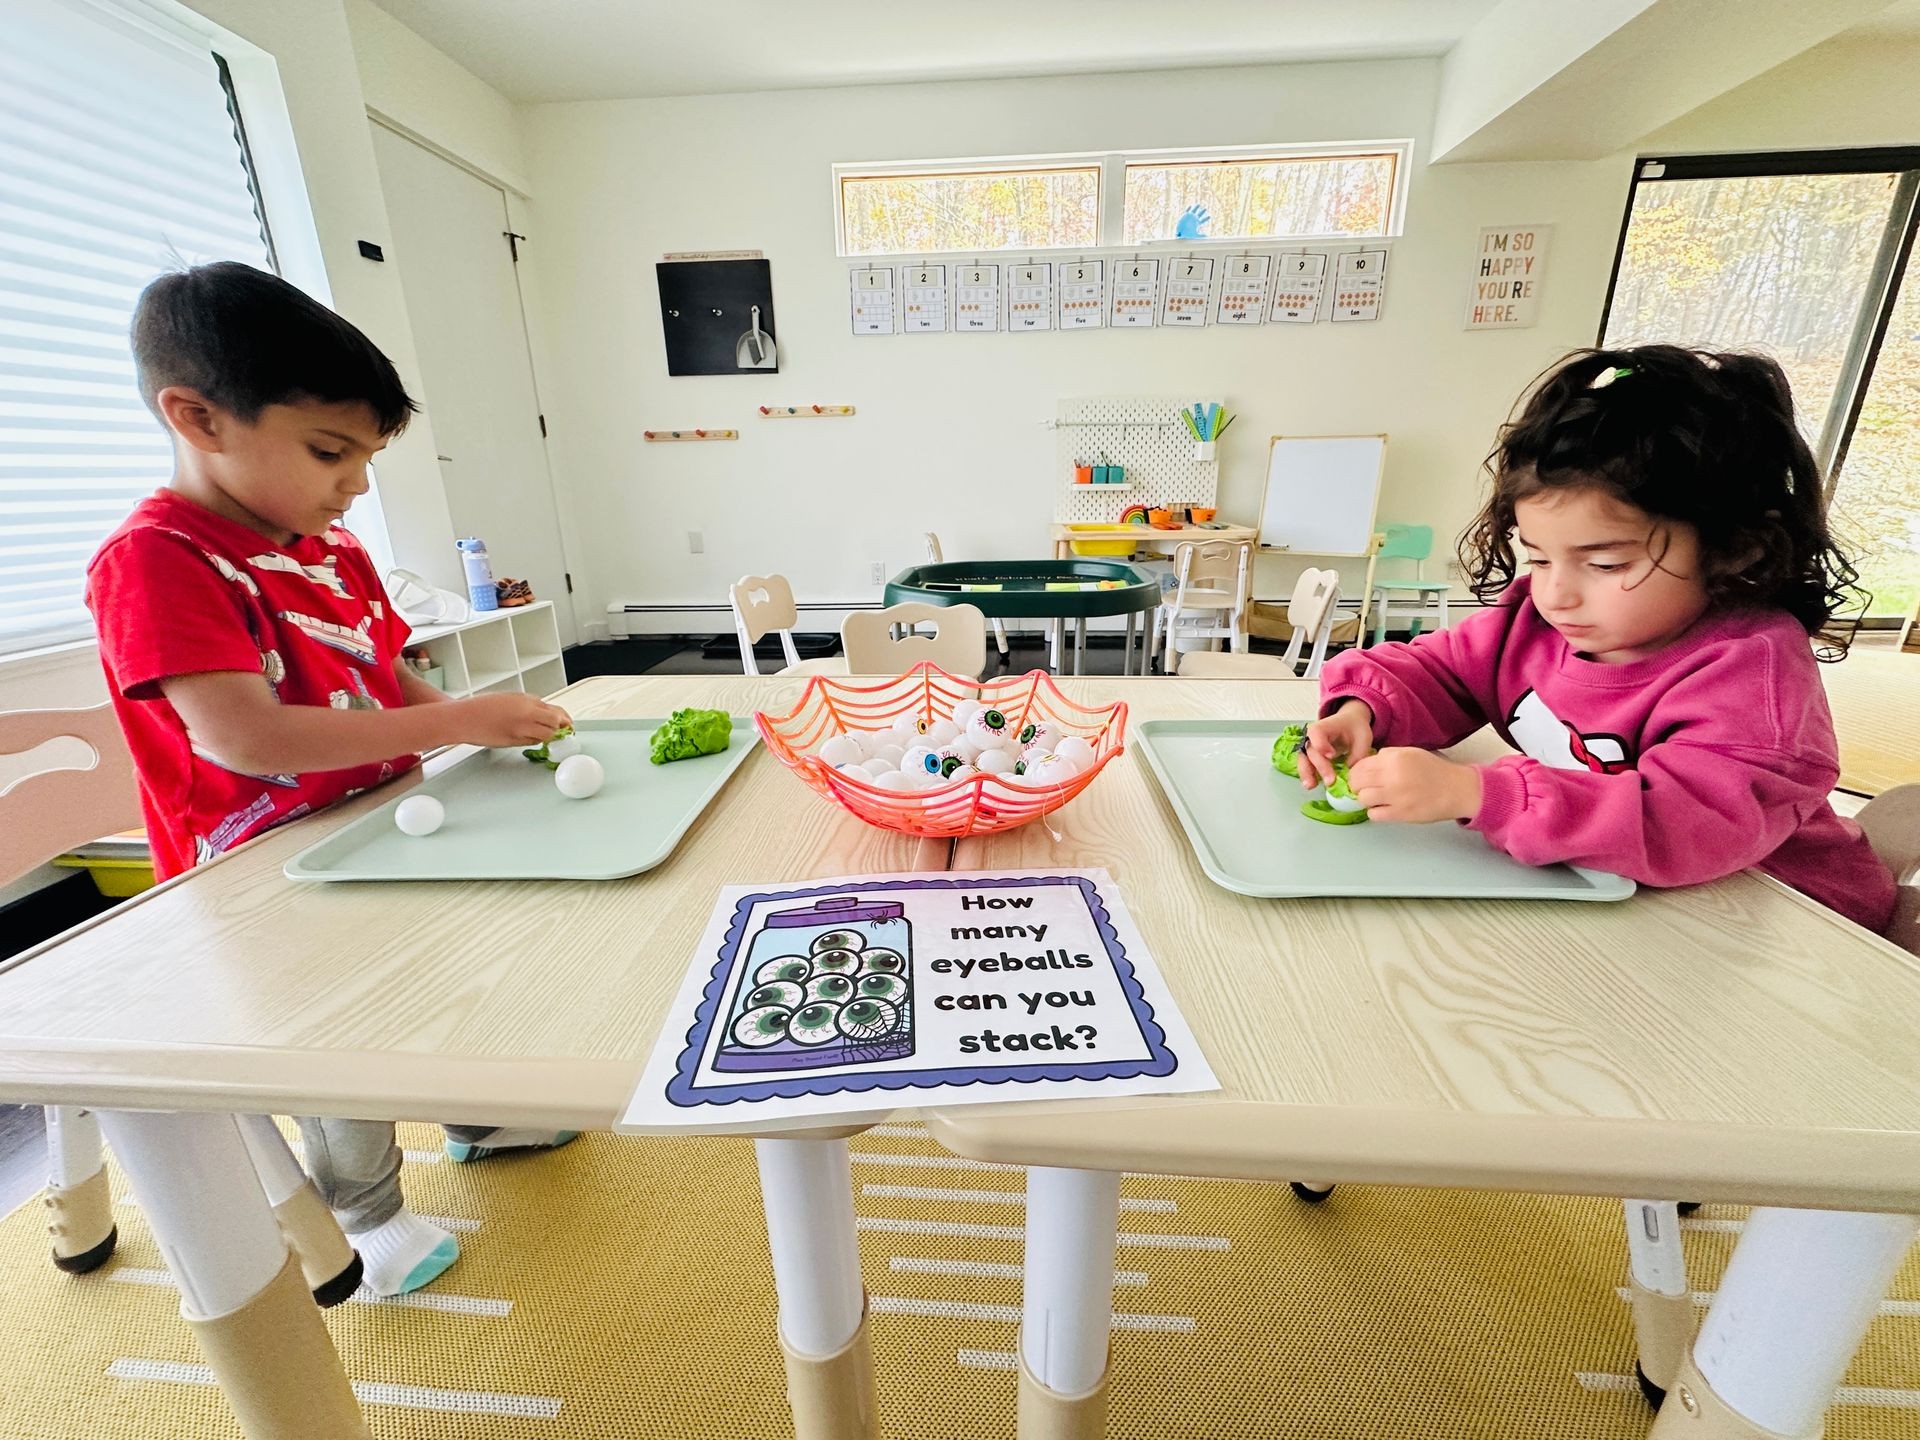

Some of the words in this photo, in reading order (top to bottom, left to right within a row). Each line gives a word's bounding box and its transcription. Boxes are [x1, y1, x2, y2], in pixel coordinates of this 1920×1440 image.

[1484, 233, 1509, 253] I'M
[1512, 232, 1535, 252] SO
[1186, 265, 1194, 275] 7
[1243, 263, 1249, 273] 8
[1298, 261, 1305, 271] 9
[1356, 259, 1366, 270] 10
[1480, 256, 1535, 276] HAPPY
[974, 272, 980, 282] 3
[1026, 271, 1032, 281] 4
[1078, 269, 1084, 279] 5
[1132, 267, 1139, 277] 6
[869, 275, 874, 286] 1
[921, 273, 927, 283] 2
[1478, 280, 1534, 300] YOU'RE
[1232, 311, 1247, 321] eight
[1472, 304, 1518, 324] HERE.
[961, 895, 1034, 911] How
[951, 924, 1048, 942] many
[930, 949, 1094, 979] eyeballs
[934, 993, 1007, 1010] can
[1017, 990, 1096, 1015] you
[959, 1024, 1098, 1053] stack?
